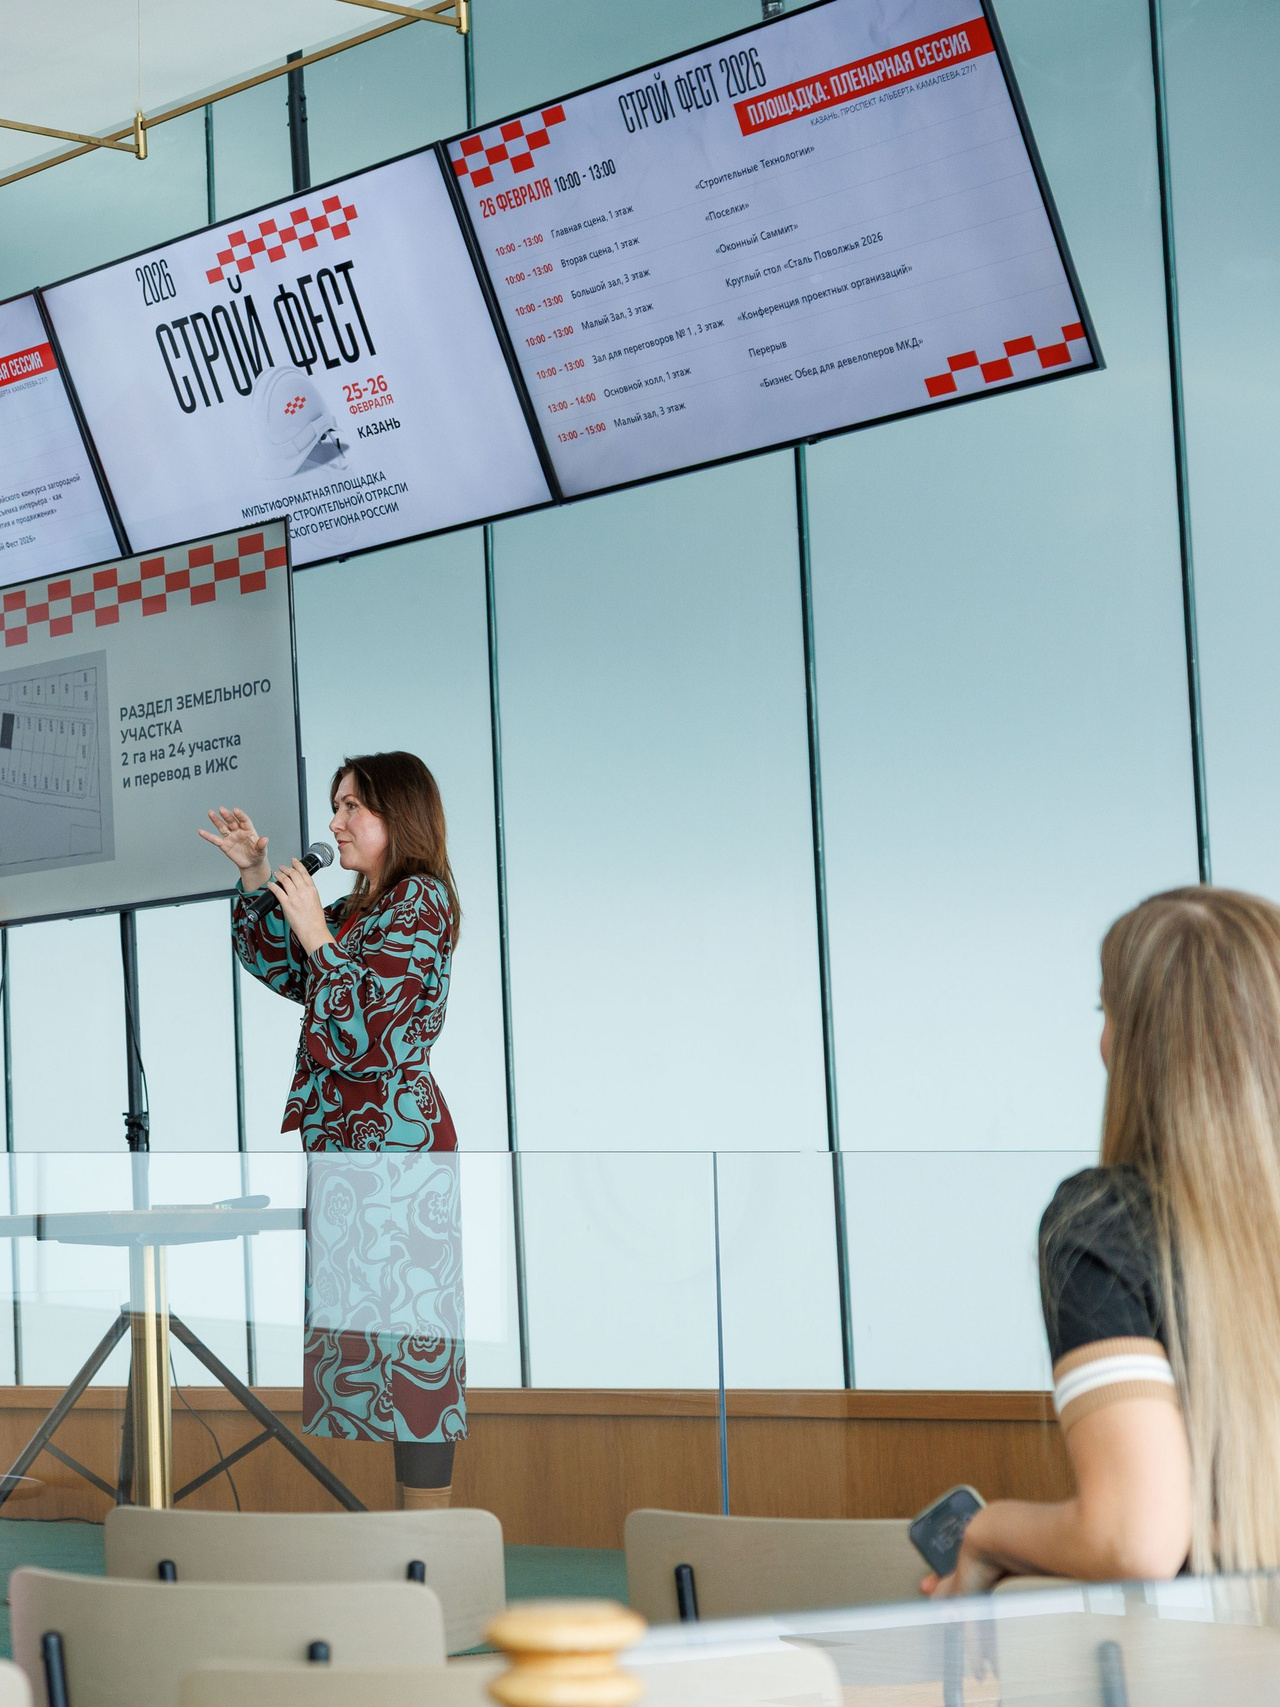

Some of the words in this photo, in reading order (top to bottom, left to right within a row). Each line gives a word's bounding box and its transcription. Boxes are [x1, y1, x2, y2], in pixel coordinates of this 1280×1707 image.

[618, 71, 676, 133] СТРОЙ
[674, 62, 720, 113] ФЕСТ
[718, 47, 767, 98] 2026
[746, 81, 831, 126] ПЛОЩАДКА:
[829, 50, 915, 97] ПЛЕНАРНАЯ
[914, 30, 971, 68] СЕССИЯ
[810, 112, 838, 126] КАЗАНЬ,
[840, 97, 876, 115] ПРОСПЕКТ
[878, 85, 915, 103] АЛЬБЕРТА
[915, 69, 961, 90] КАМАЛЕЕВА
[960, 63, 977, 76] 27/1
[695, 164, 759, 189] «Строительные
[759, 146, 815, 168] Технологии»
[479, 197, 497, 218] 26
[495, 177, 553, 212] ФЕВРАЛЯ
[554, 171, 581, 193] 10:00
[588, 159, 616, 181] 13:00
[550, 222, 582, 238] Главная
[582, 214, 608, 228] сцена,
[608, 210, 613, 219] 1
[614, 205, 634, 218] этаж
[705, 203, 749, 221] «Поселки»
[495, 242, 516, 256] 10:00
[522, 233, 544, 247] 13:00
[560, 253, 588, 268] Вторая
[588, 246, 614, 259] сцена,
[614, 241, 619, 250] 1
[620, 237, 640, 249] этаж
[715, 233, 759, 254] «Оконный
[759, 224, 798, 241] Саммит»
[505, 272, 526, 285] 10:00
[532, 263, 553, 276] 13:00
[725, 268, 762, 288] Круглый
[762, 264, 782, 276] стол
[783, 256, 813, 269] «Сталь
[813, 241, 860, 260] Поволжья
[860, 231, 883, 247] 2026
[135, 258, 177, 306] 2026
[570, 280, 606, 299] Большой
[607, 278, 624, 288] зал,
[623, 273, 630, 283] 3
[630, 269, 651, 281] этаж
[737, 298, 800, 321] «Конференция
[801, 283, 849, 304] проектных
[850, 263, 913, 290] организаций»
[515, 303, 536, 316] 10:00
[542, 294, 564, 308] 13:00
[581, 314, 610, 330] Малый
[609, 312, 627, 322] Зал,
[627, 307, 633, 317] 3
[634, 303, 654, 315] этаж
[154, 274, 275, 414] СТРОЙ
[273, 259, 376, 376] ФЕСТ
[525, 333, 546, 347] 10:00
[552, 325, 574, 338] 13:00
[591, 354, 607, 364] Зал
[608, 349, 623, 361] для
[623, 334, 675, 355] переговоров
[675, 328, 686, 339] №
[686, 327, 692, 335] 1
[696, 323, 703, 333] 3
[704, 319, 725, 331] этаж
[748, 341, 787, 358] Перерыв
[8, 351, 43, 376] СЕССИЯ
[536, 366, 557, 379] 10:00
[563, 358, 585, 372] 13:00
[759, 373, 793, 388] «Бизнес
[794, 367, 819, 379] Обед
[819, 362, 835, 374] для
[837, 346, 895, 369] девелоперов
[895, 337, 923, 351] МКД»
[342, 374, 388, 403] 25-26
[603, 379, 643, 398] Основной
[644, 375, 666, 386] холл,
[665, 371, 671, 380] 1
[671, 367, 692, 379] этаж
[349, 393, 394, 415] ФЕВРАЛЯ
[547, 400, 568, 413] 13:00
[575, 392, 596, 405] 14:00
[613, 412, 642, 427] Малый
[642, 410, 659, 420] зал,
[659, 406, 665, 416] 3
[666, 402, 686, 414] этаж
[357, 417, 401, 439] КАЗАНЬ
[557, 430, 578, 442] 13:00
[584, 422, 606, 435] 15:00
[241, 485, 331, 519] МУЛЬТИФОРМАТНАЯ
[330, 471, 386, 494] ПЛОЩАДКА
[292, 491, 365, 521] СТРОИТЕЛЬНОЙ
[364, 482, 409, 502] ОТРАСЛИ
[318, 512, 361, 531] РЕГИОНА
[360, 501, 399, 520] РОССИИ
[5, 540, 18, 548] Фест
[19, 534, 36, 545] 2026»
[120, 697, 173, 721] РАЗДЕЛ
[176, 678, 271, 710] ЗЕМЕЛЬНОГО
[120, 719, 183, 744] УЧАСТКА
[121, 751, 129, 766] 2
[133, 751, 146, 764] га
[149, 748, 165, 761] на
[168, 741, 186, 758] 24
[188, 734, 241, 757] участка
[123, 776, 131, 789] и
[134, 766, 191, 787] перевод
[194, 764, 202, 776] в
[205, 754, 238, 774] ИЖС
